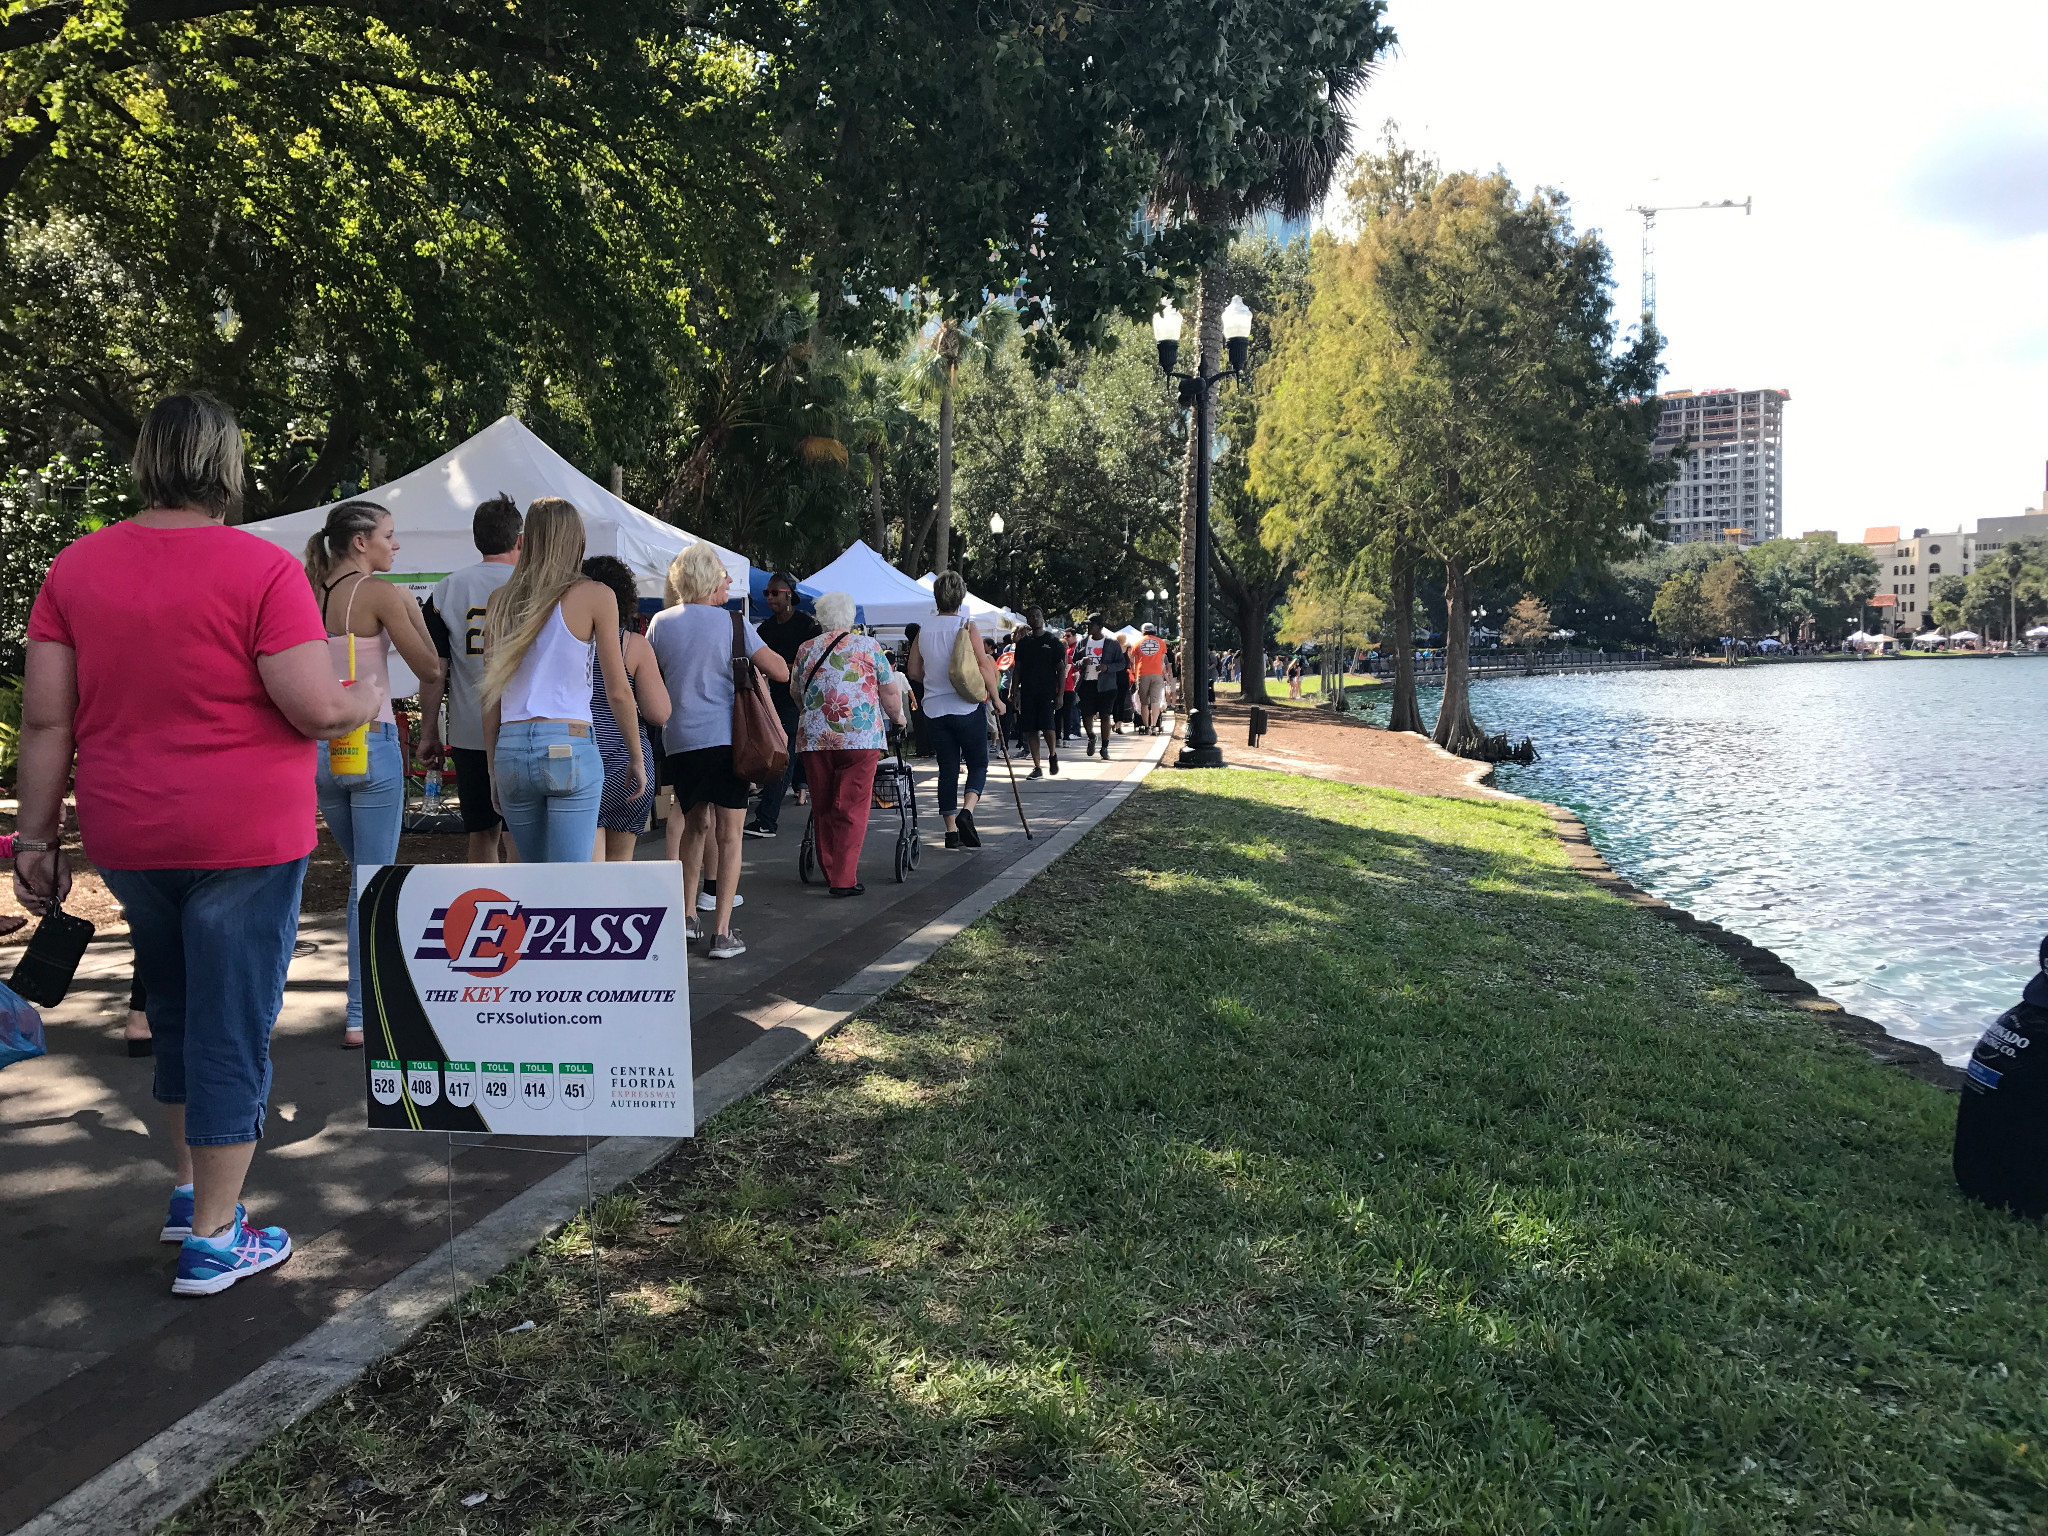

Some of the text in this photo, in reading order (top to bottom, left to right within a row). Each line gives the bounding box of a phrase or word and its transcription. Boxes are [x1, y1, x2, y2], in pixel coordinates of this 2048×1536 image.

[425, 986, 676, 1003] THE KEY TO YOUR COMMUTE
[476, 1012, 602, 1025] CFXSolution.com
[375, 1060, 396, 1069] TOLL
[412, 1061, 433, 1070] TOLL
[449, 1062, 470, 1071] TOLL
[487, 1063, 508, 1072] TOLL
[526, 1064, 547, 1072] TOLL
[565, 1064, 587, 1073] TOLL
[610, 1066, 674, 1077] CENTRAL
[374, 1078, 395, 1094] 528
[411, 1079, 432, 1095] 408
[485, 1081, 507, 1097] 429
[611, 1078, 676, 1089] FLORIDA
[448, 1082, 470, 1097] 417
[524, 1082, 546, 1098] 414
[564, 1083, 585, 1098] 451
[611, 1090, 676, 1099] EXPRESSWAY
[610, 1099, 676, 1109] AUTHORITY
